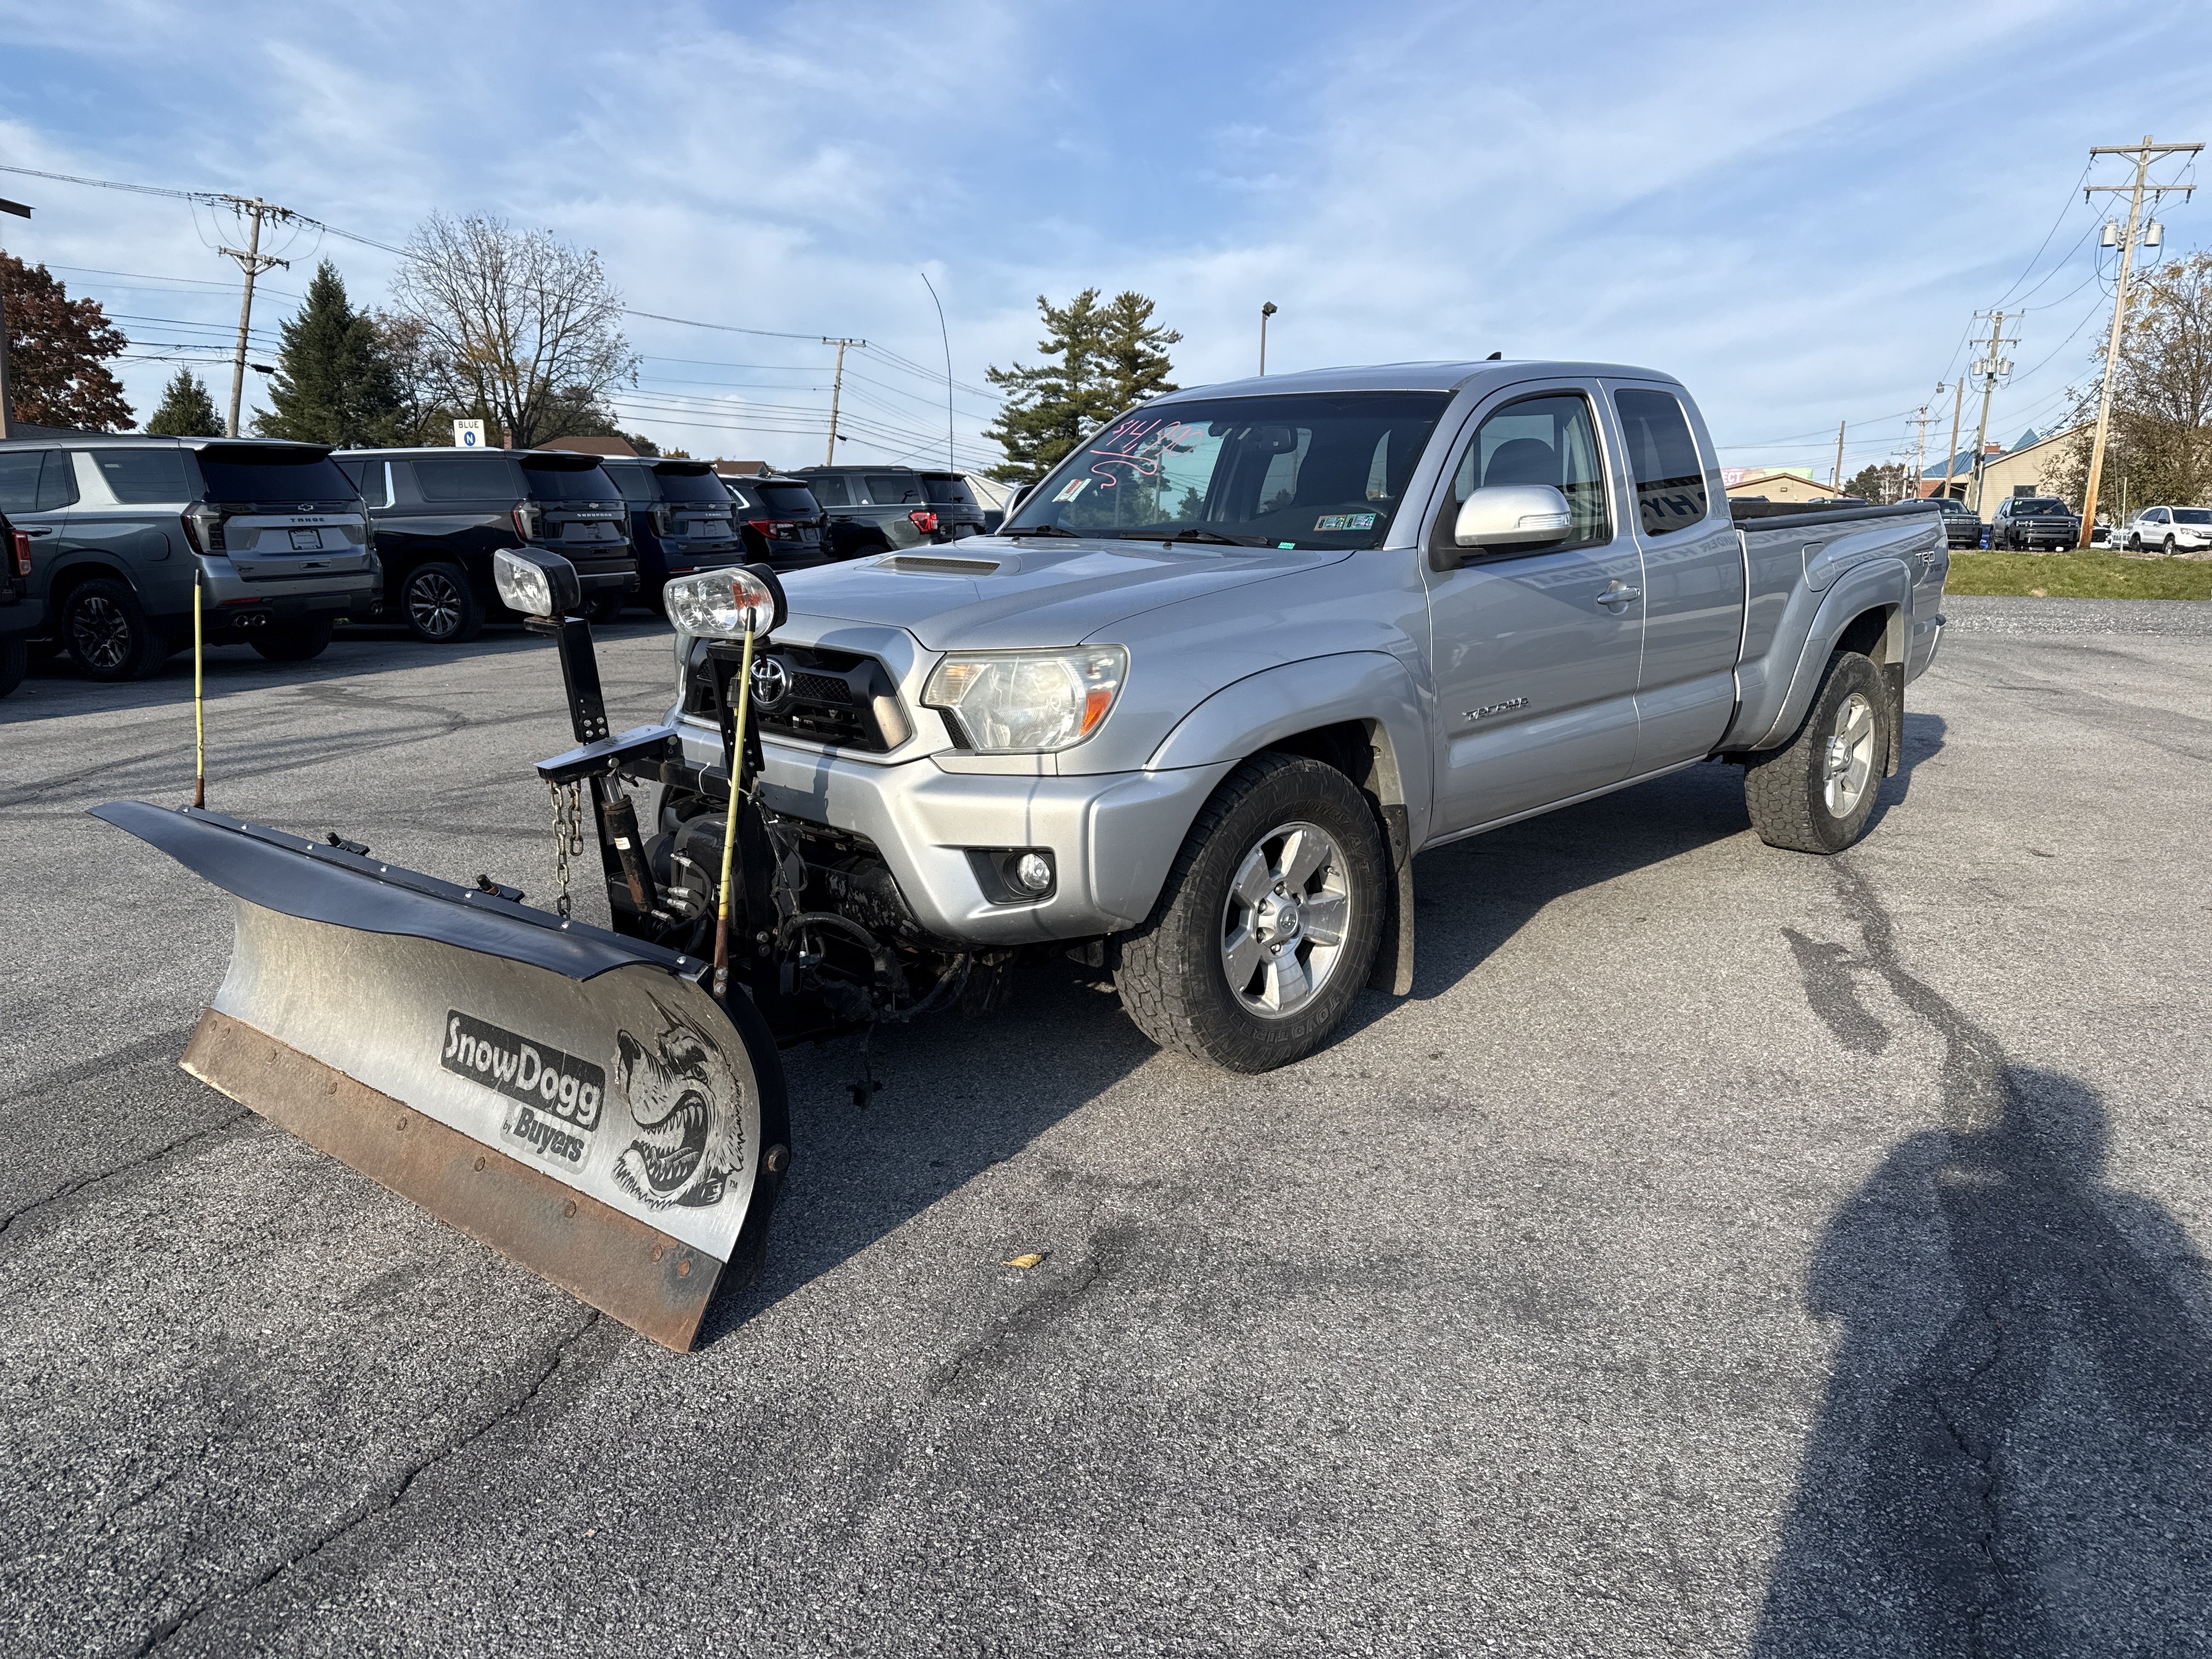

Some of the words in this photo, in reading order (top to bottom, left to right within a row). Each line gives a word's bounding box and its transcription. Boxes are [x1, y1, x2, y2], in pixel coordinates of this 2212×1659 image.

[466, 434, 473, 444] N
[1724, 472, 1743, 483] ECT
[1318, 519, 1325, 528] 8
[1347, 518, 1353, 528] 8
[1915, 551, 1936, 568] TRD
[1463, 697, 1529, 721] TACOMA
[1292, 994, 1340, 1039] TOYO
[445, 1017, 601, 1125] SnowDogg
[503, 1119, 511, 1134] by
[513, 1107, 585, 1162] Buyers
[730, 1180, 738, 1189] TM
